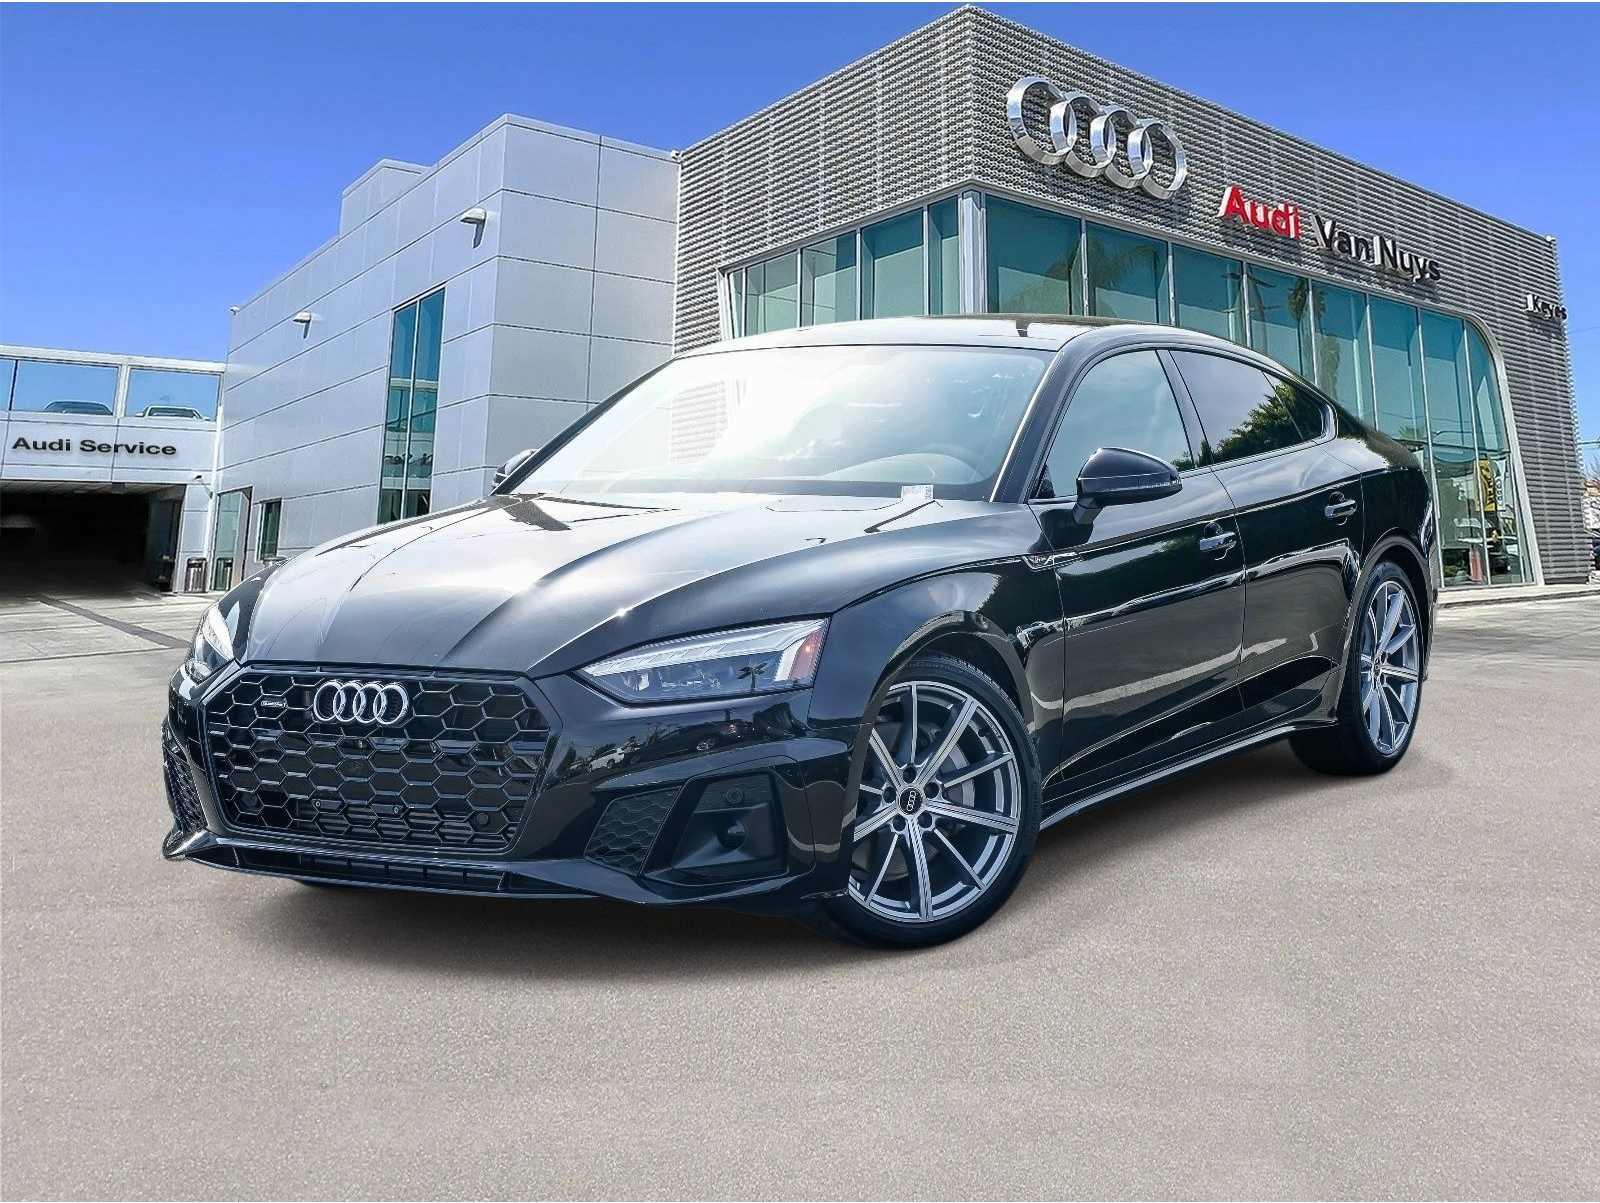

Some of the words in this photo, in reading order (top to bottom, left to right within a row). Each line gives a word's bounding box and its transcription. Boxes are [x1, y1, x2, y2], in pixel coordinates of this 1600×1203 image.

[1218, 184, 1302, 241] Audi
[1311, 213, 1369, 261] Van
[1373, 234, 1441, 282] Nuys
[1526, 293, 1567, 320] Keyes
[12, 436, 71, 452] Audi
[79, 438, 177, 456] Service
